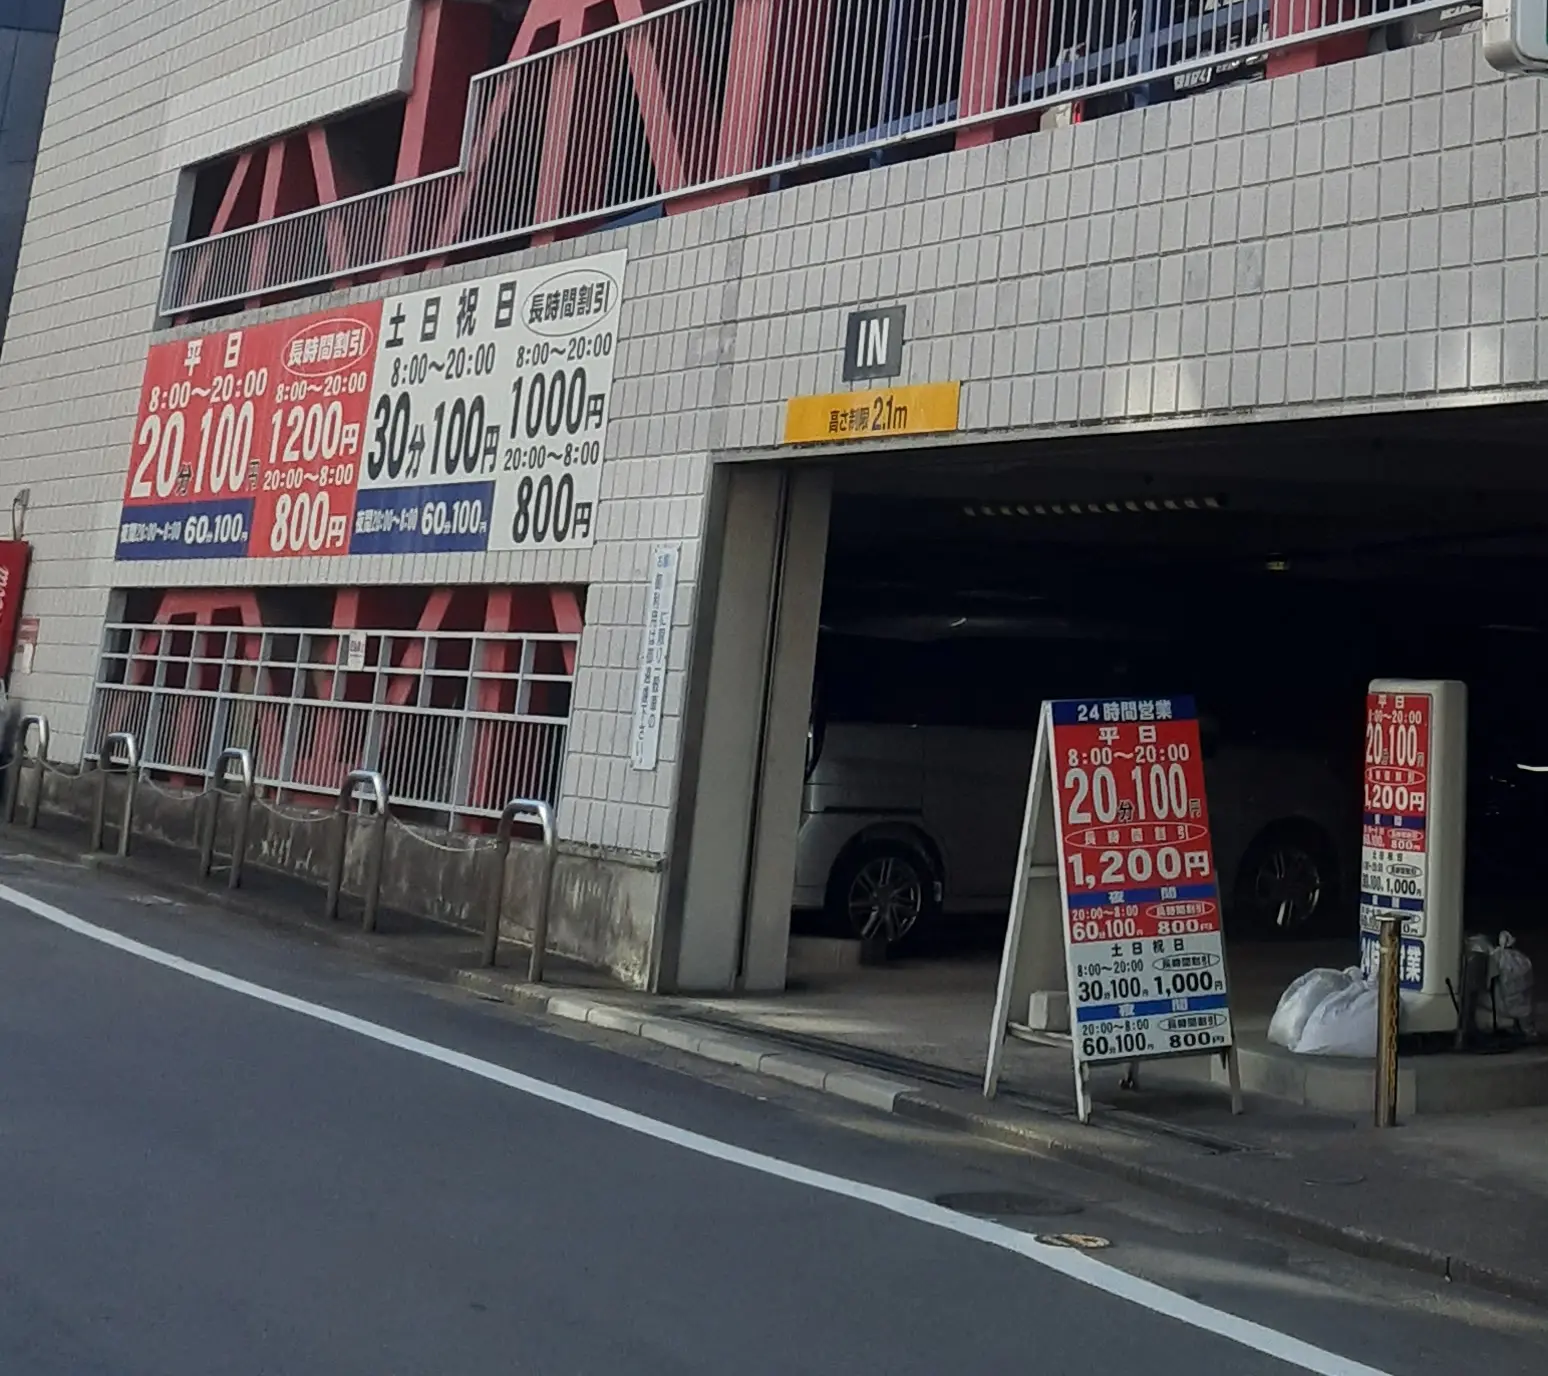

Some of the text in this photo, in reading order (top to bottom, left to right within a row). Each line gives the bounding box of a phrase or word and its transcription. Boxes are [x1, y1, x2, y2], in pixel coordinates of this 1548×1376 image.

[529, 281, 610, 324] 長時間割引
[184, 331, 242, 376] 平日
[287, 327, 366, 367] 長時間割引
[857, 317, 889, 367] IN
[510, 367, 605, 439] 1000円
[270, 401, 360, 463] 1200円
[271, 491, 347, 551] 800円
[512, 473, 592, 543] 800円
[1077, 700, 1172, 721] 24時間営業
[1099, 725, 1156, 745] 平日
[1068, 847, 1210, 889] 1,200円
[1112, 939, 1184, 957] 土日祝日
[1154, 972, 1223, 996] 1,000円
